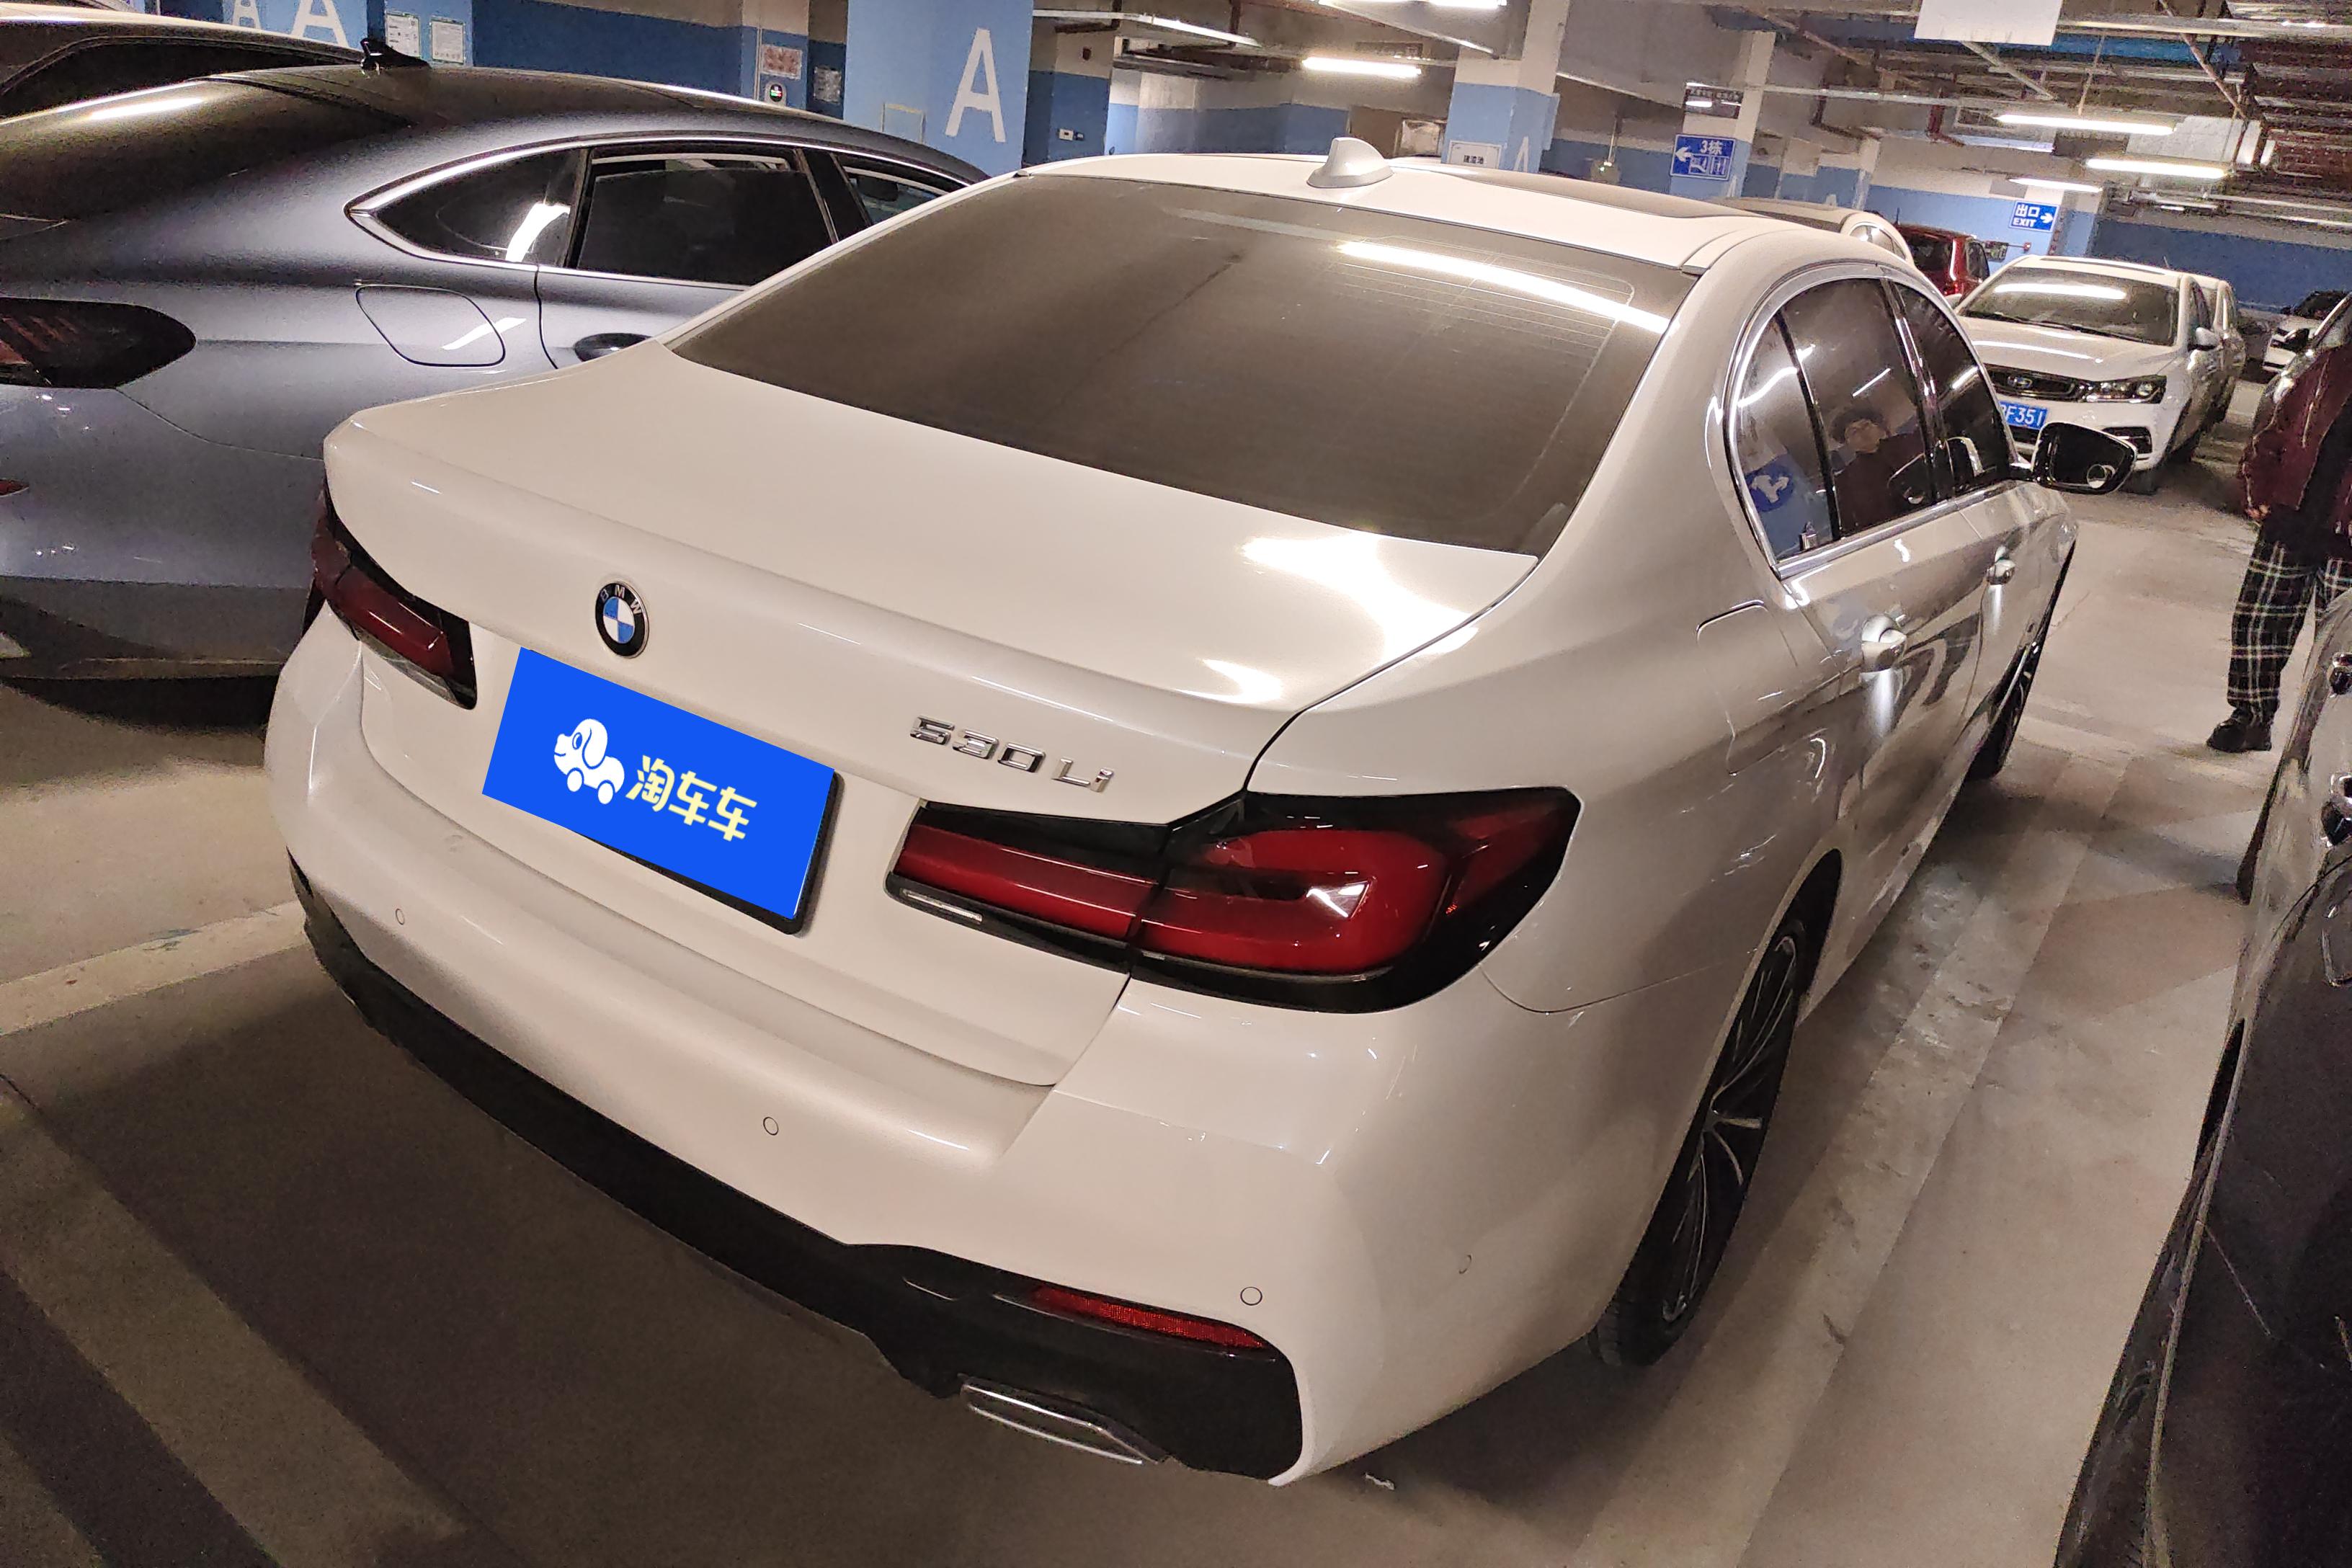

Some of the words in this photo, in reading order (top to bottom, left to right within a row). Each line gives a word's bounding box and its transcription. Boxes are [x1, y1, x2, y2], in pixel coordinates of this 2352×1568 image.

[290, 0, 349, 48] A
[945, 27, 1006, 143] A
[1700, 140, 1723, 156] 3栋
[2012, 217, 2036, 228] EXIT
[2015, 203, 2041, 218] 出口
[600, 584, 643, 615] BMW
[909, 716, 1046, 773] 530
[1051, 757, 1115, 793] Li
